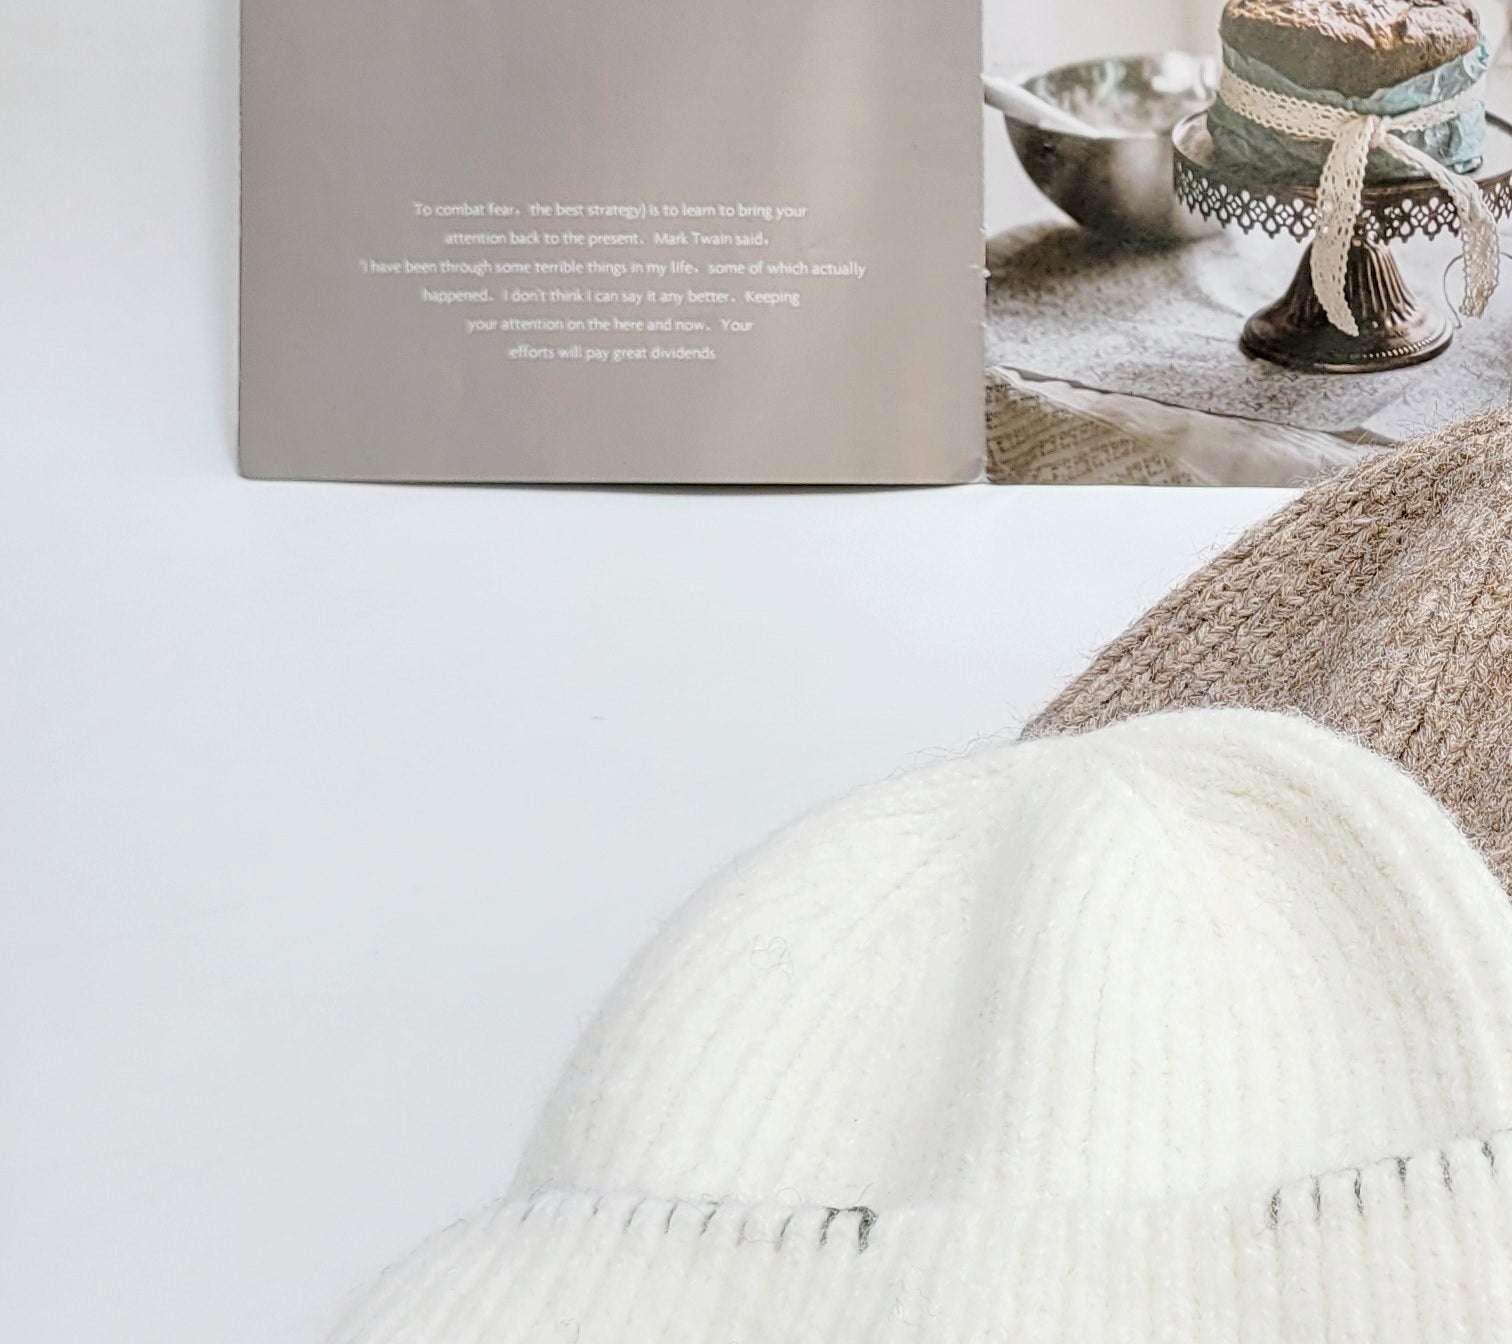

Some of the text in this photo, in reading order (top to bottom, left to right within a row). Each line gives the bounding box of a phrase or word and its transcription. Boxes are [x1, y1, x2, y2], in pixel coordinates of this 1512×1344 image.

[413, 201, 432, 216] To
[435, 202, 488, 216] combat
[528, 201, 551, 217] the
[556, 202, 584, 216] best
[650, 204, 660, 216] is
[664, 205, 679, 216] to
[683, 203, 716, 216] learn
[719, 204, 735, 217] to
[739, 202, 772, 221] bring
[776, 207, 808, 221] your
[445, 232, 506, 245] attention
[510, 231, 539, 244] back
[544, 232, 560, 244] to
[563, 231, 585, 245] the
[655, 231, 688, 245] Mark
[691, 231, 733, 245] Twain
[370, 258, 402, 273] have
[404, 258, 437, 273] been
[440, 259, 492, 277] through
[495, 263, 531, 274] some
[535, 259, 584, 274] terrible
[588, 260, 626, 277] things
[631, 261, 643, 274] in
[647, 263, 667, 277] my
[708, 263, 745, 275] some
[749, 259, 764, 275] of
[767, 261, 808, 275] which
[812, 261, 866, 280] actually
[551, 288, 584, 302] think
[595, 292, 618, 303] can
[622, 292, 642, 306] say
[647, 290, 657, 303] it
[660, 292, 683, 306] any
[744, 290, 800, 307] Keeping
[467, 319, 498, 335] your
[501, 319, 564, 331] attention
[567, 320, 585, 331] on
[588, 318, 611, 331] the
[614, 318, 644, 331] here
[647, 318, 672, 331] and
[721, 318, 754, 332] Your
[509, 344, 717, 363] efforts will pay great dividends
